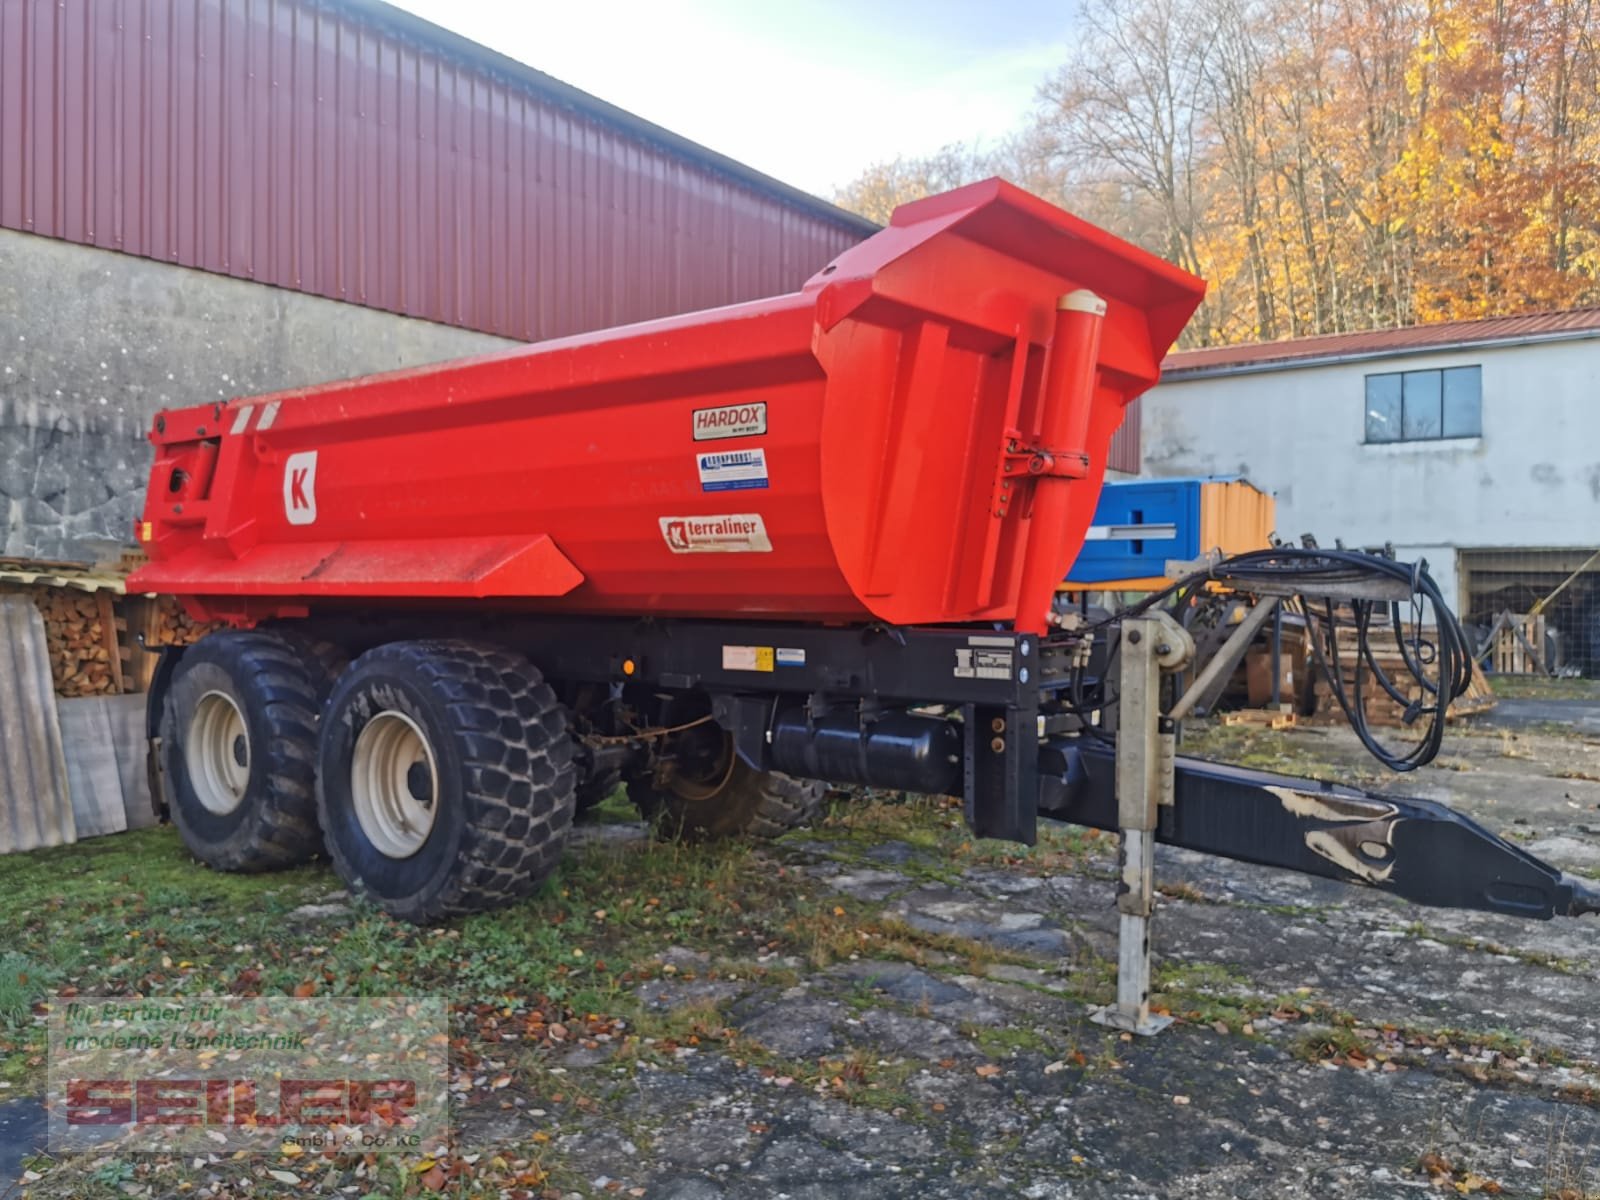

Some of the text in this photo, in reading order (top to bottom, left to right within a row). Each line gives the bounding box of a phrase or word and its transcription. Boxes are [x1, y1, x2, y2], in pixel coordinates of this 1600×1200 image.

[697, 406, 760, 429] HARDOX
[291, 467, 310, 510] K
[688, 517, 757, 536] terraliner
